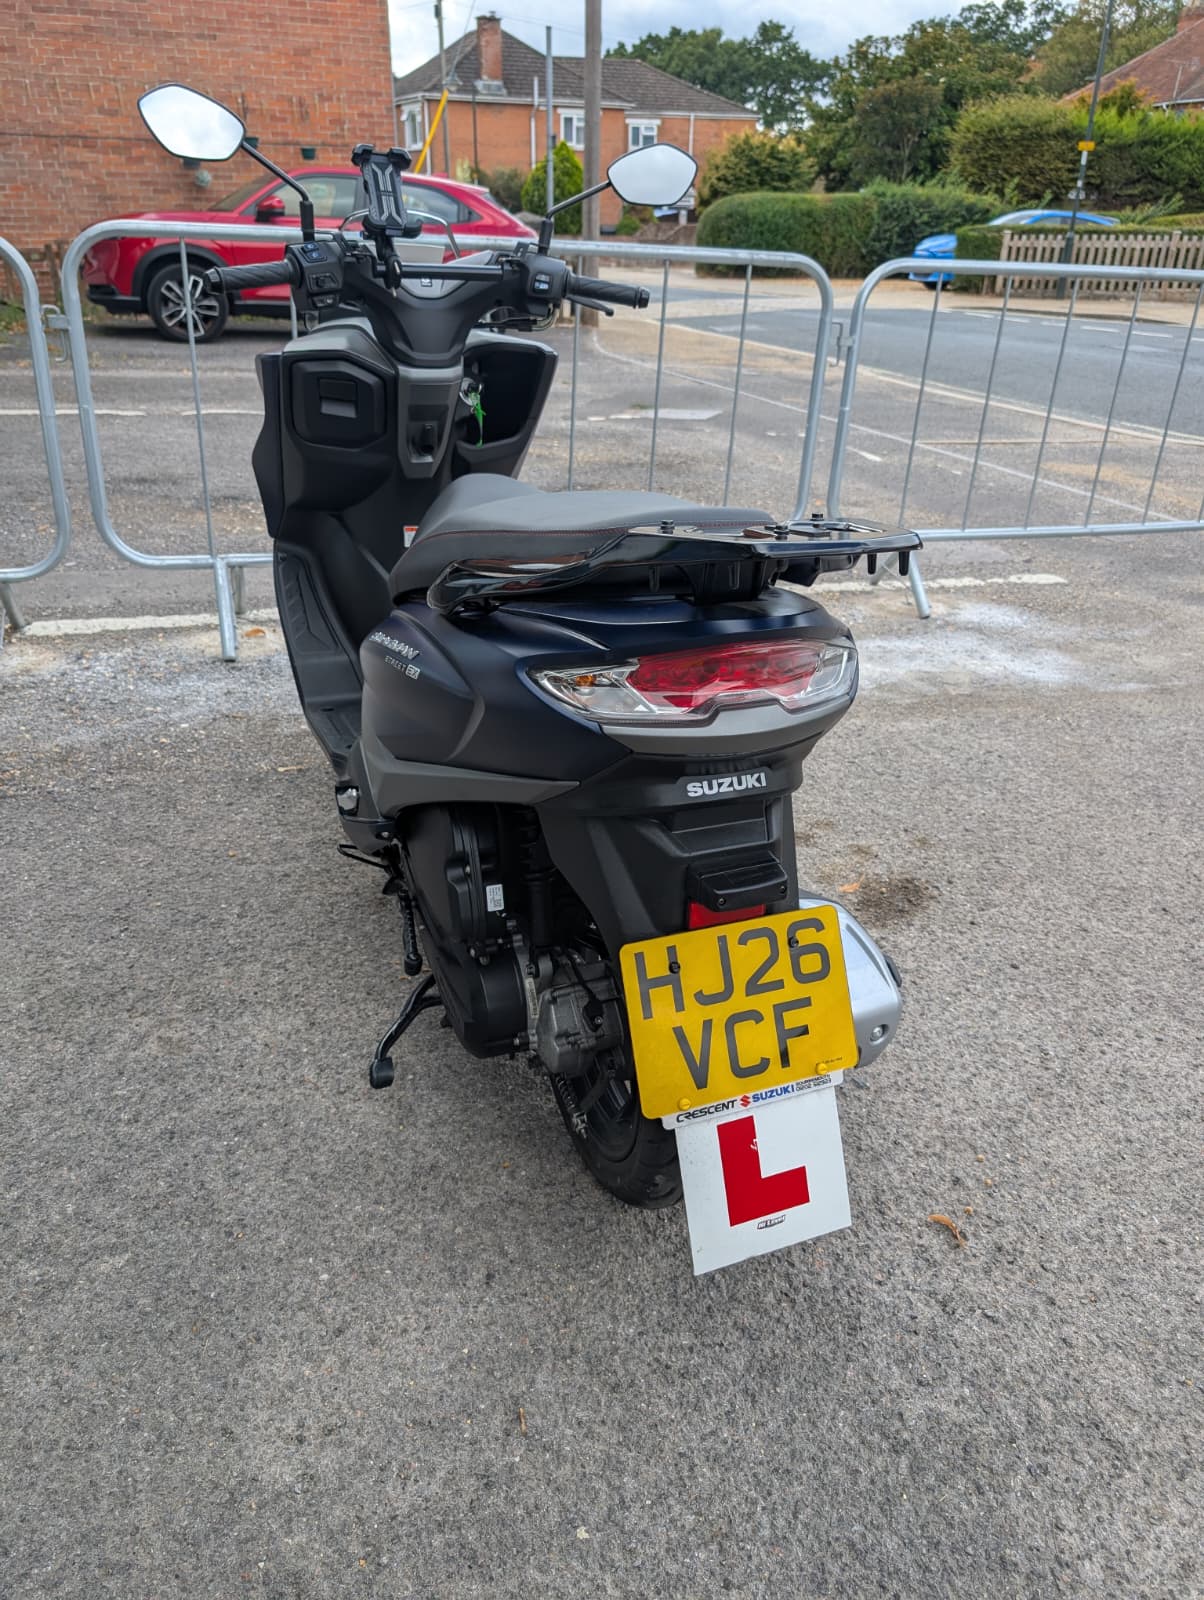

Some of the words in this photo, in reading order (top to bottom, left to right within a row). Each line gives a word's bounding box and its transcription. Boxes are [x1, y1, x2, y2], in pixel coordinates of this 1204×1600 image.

[686, 772, 767, 797] SUZUKI
[634, 918, 831, 1020] HJ26
[672, 996, 812, 1090] VCF
[676, 1099, 738, 1124] CRESCENT
[752, 1084, 795, 1103] SUZUKI
[716, 1115, 811, 1227] L
